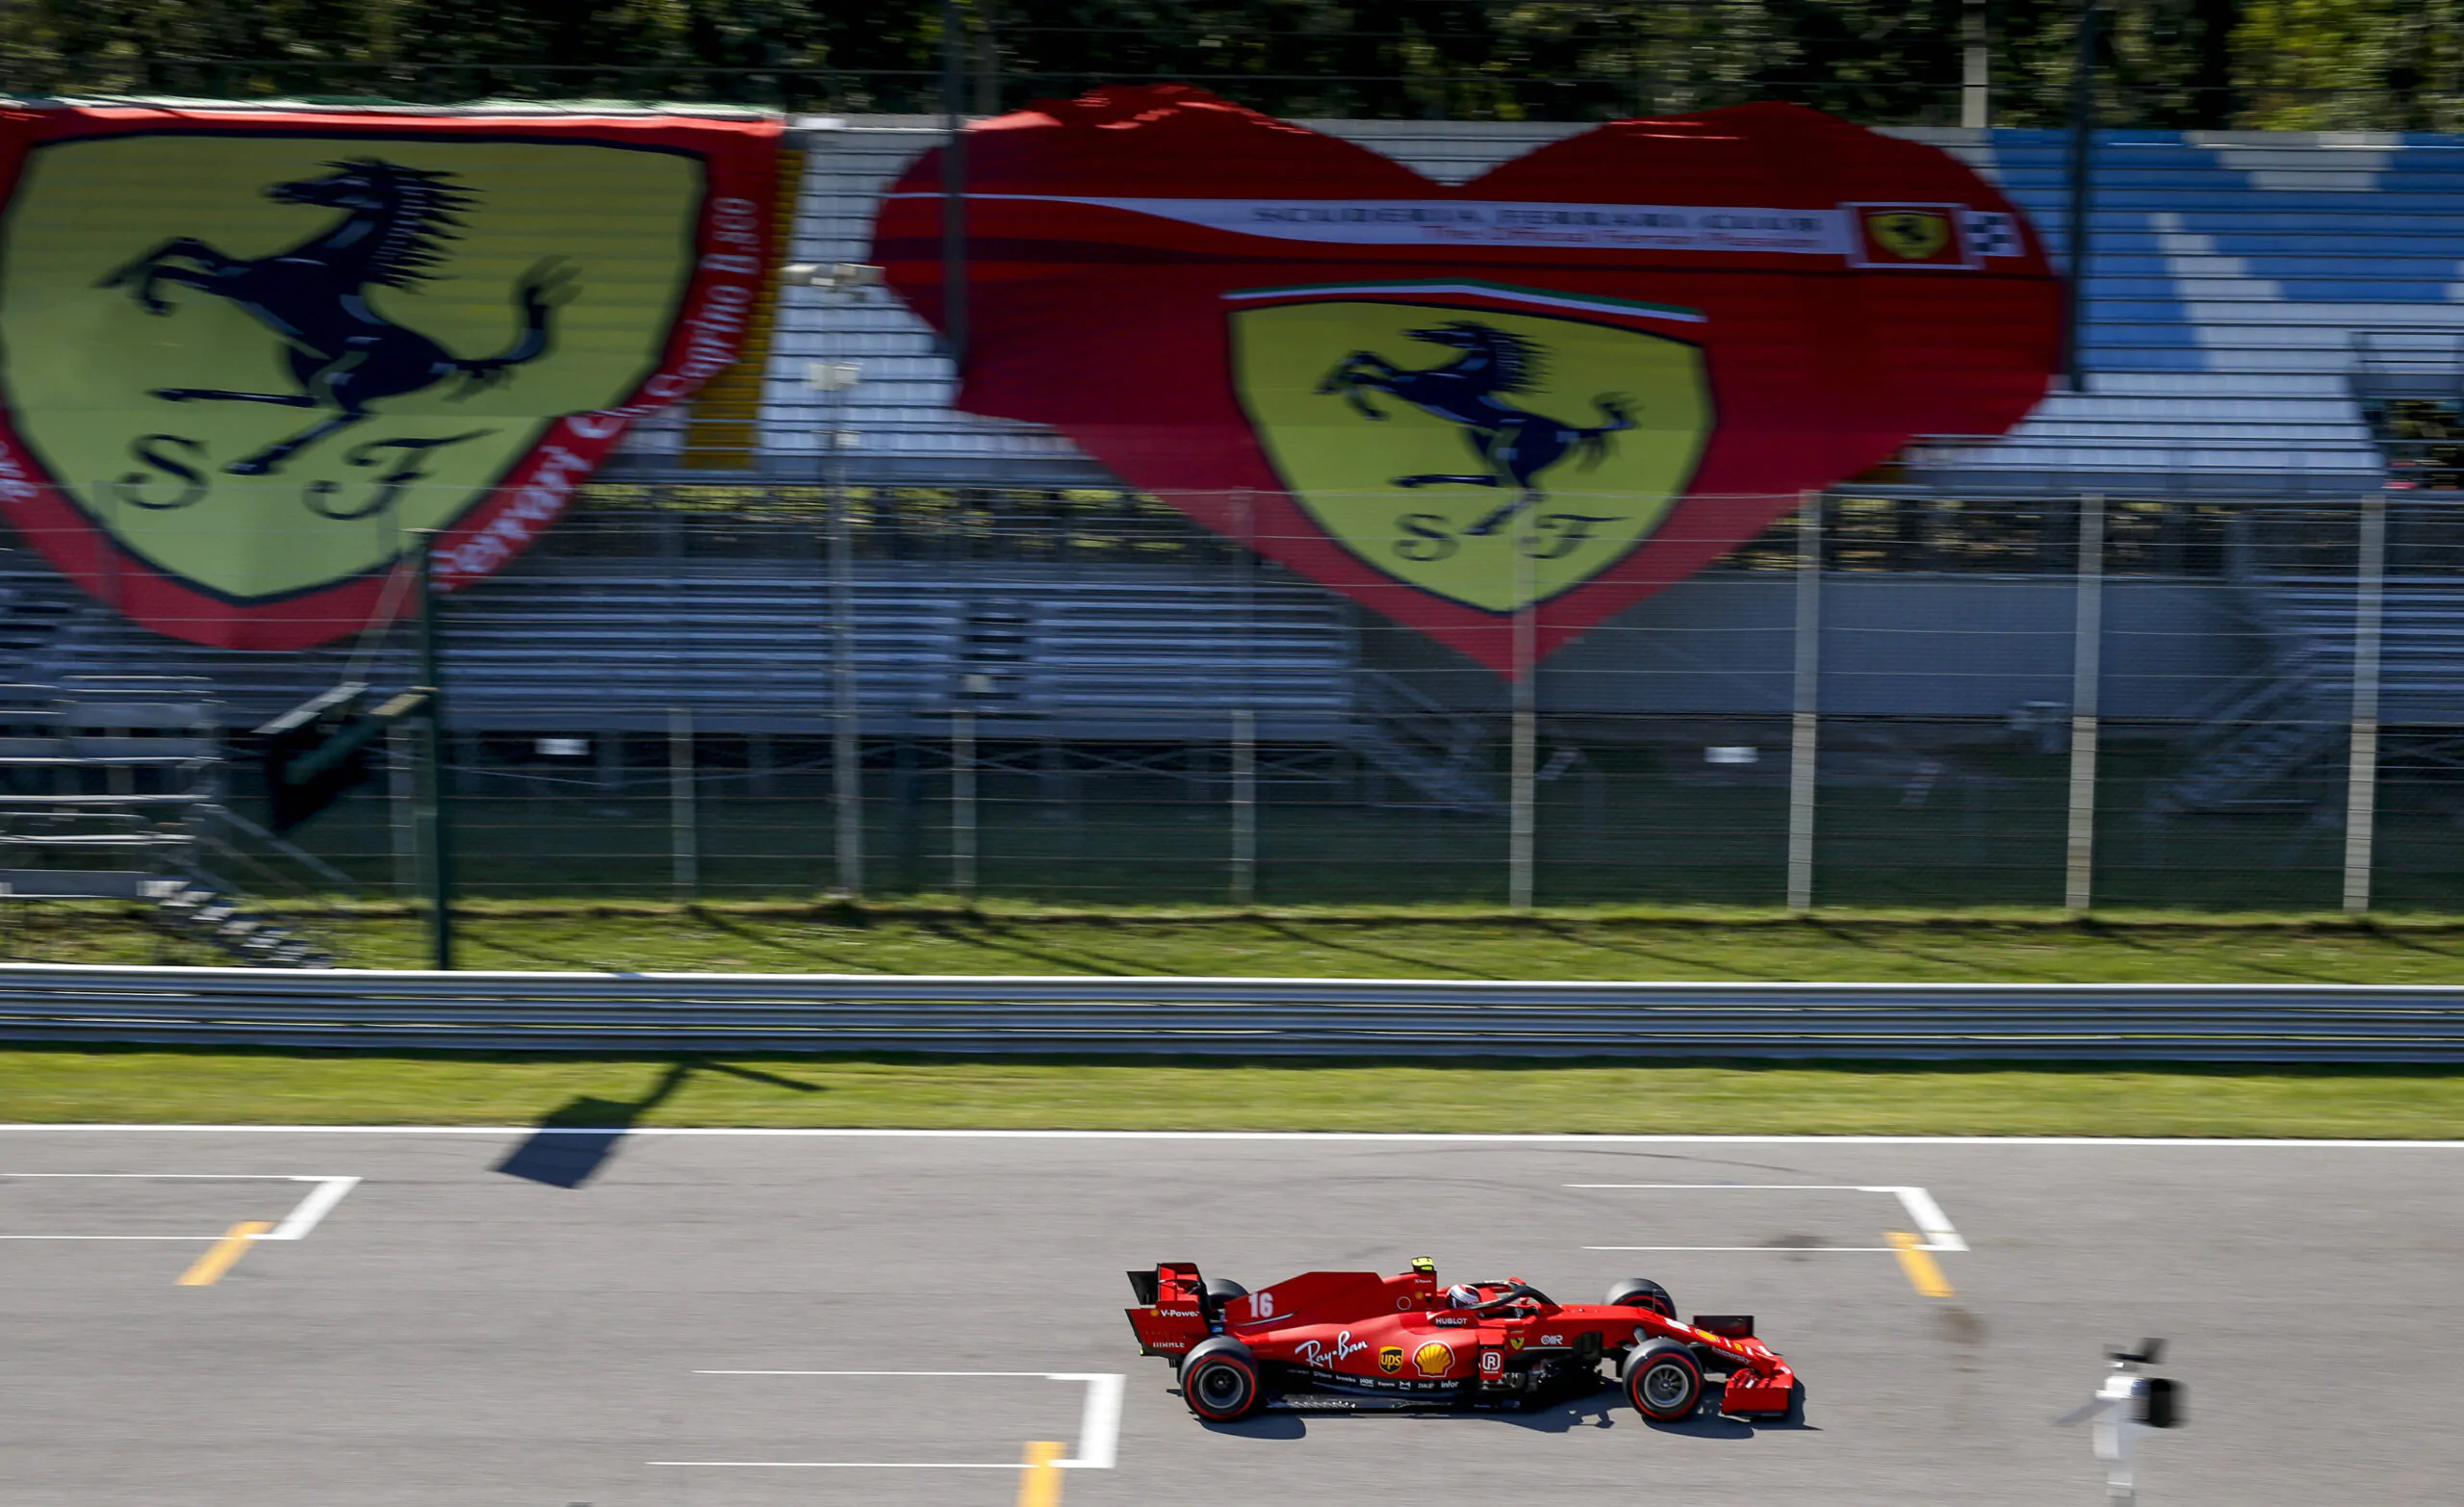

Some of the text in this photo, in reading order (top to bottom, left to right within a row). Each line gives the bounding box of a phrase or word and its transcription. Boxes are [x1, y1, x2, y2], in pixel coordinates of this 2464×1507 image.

[1494, 210, 1689, 228] FERRARI
[113, 433, 211, 511] S
[1391, 513, 1460, 562] S
[1248, 1292, 1273, 1317] 16
[1380, 1353, 1402, 1370] ups
